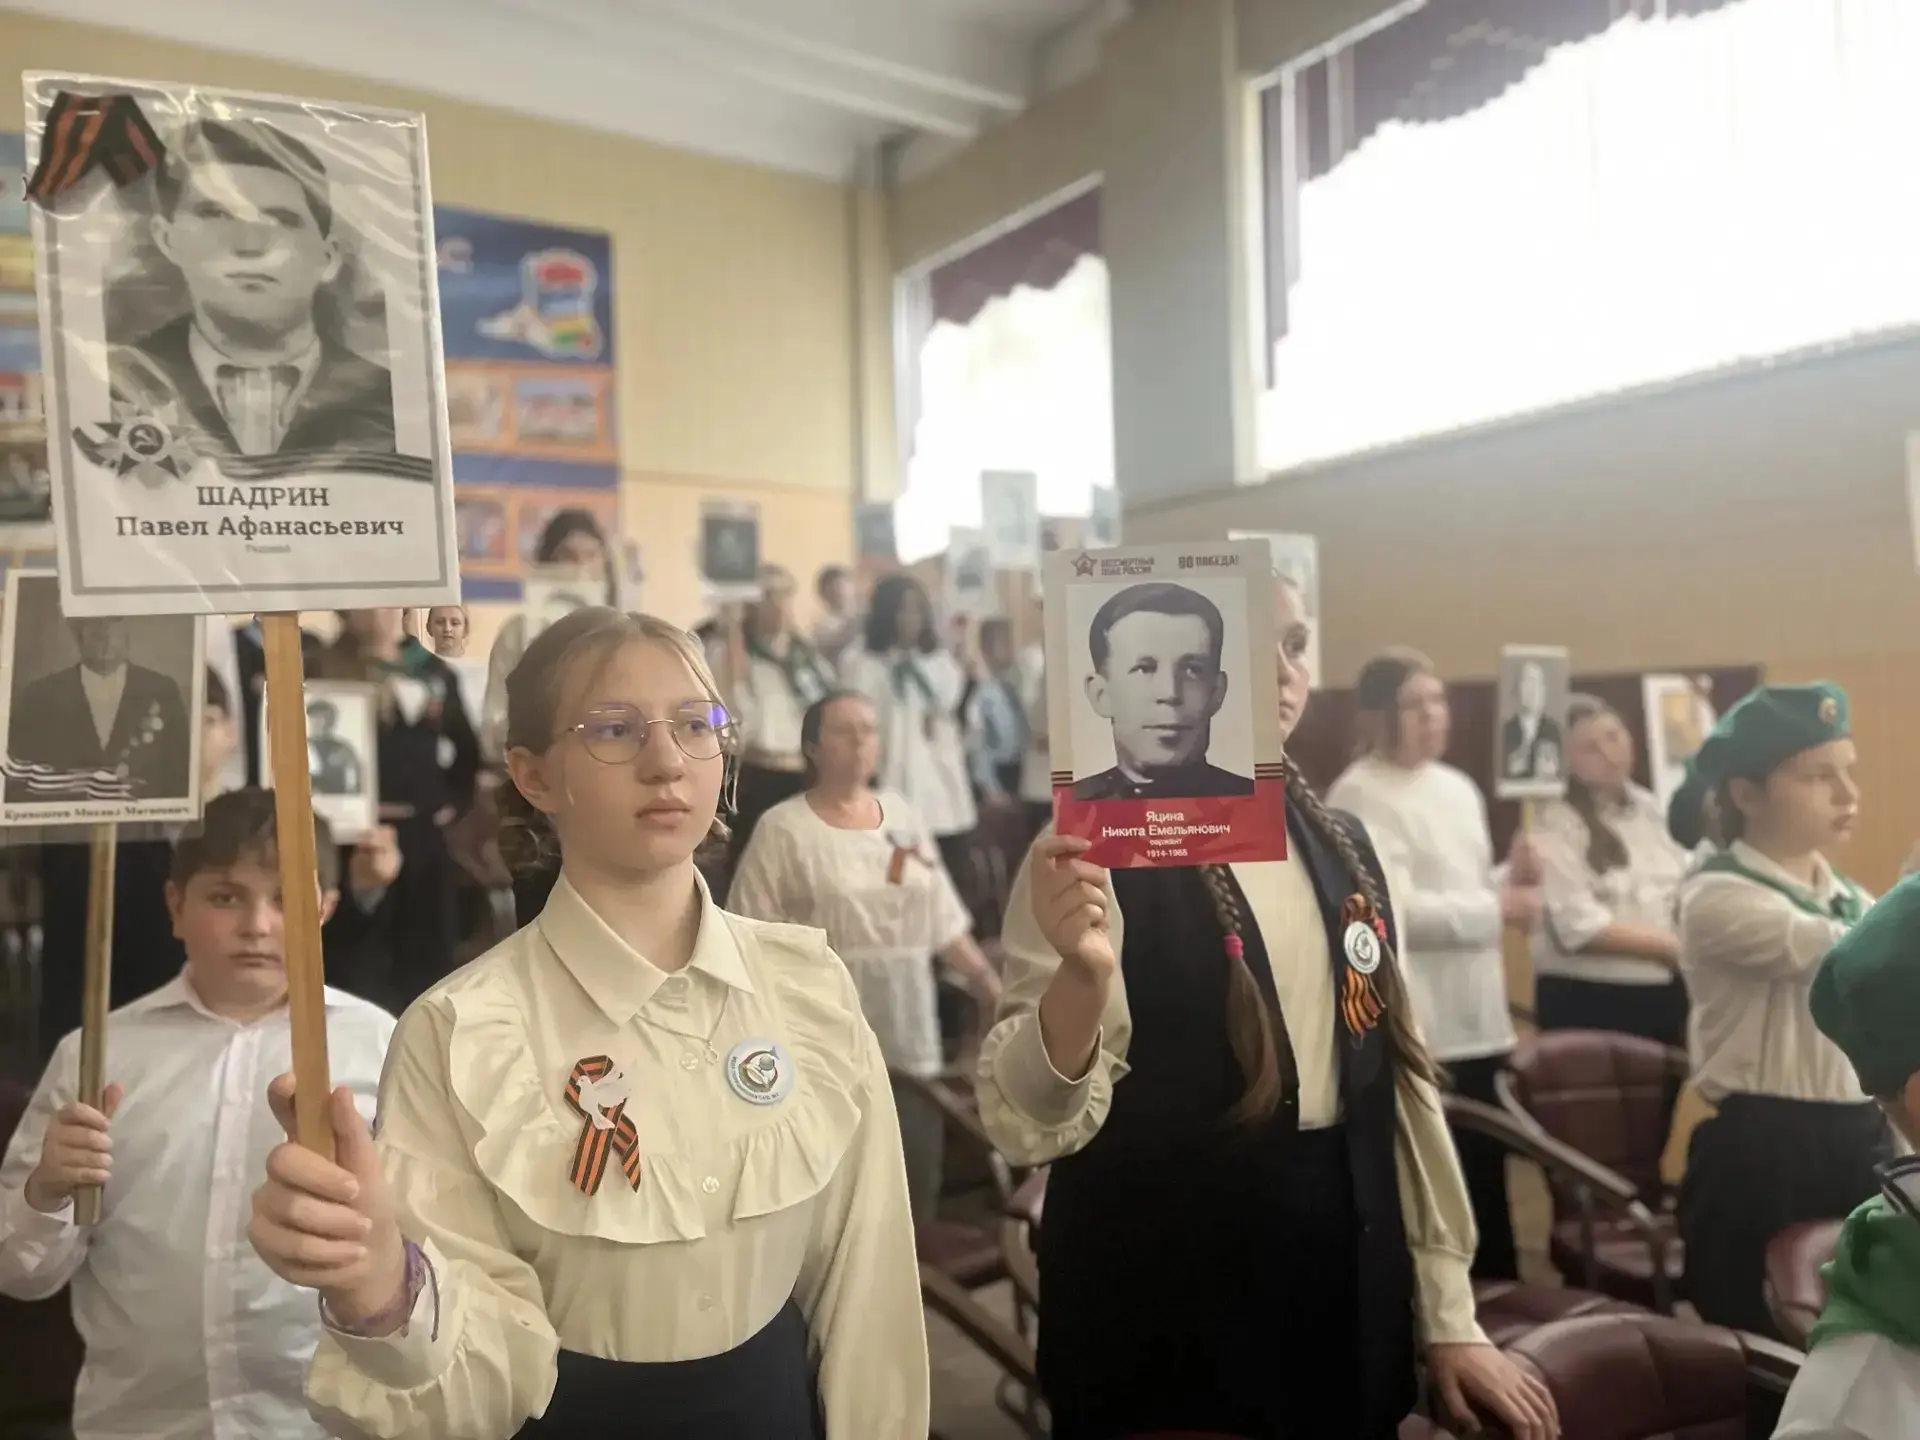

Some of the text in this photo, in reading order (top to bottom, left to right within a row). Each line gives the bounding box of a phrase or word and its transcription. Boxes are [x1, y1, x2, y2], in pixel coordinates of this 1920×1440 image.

[196, 486, 329, 510] ШАДРИН
[115, 515, 404, 540] Павел Афанасьевич
[1145, 811, 1184, 823] Яцина
[1102, 824, 1231, 837] Никита Емельянович
